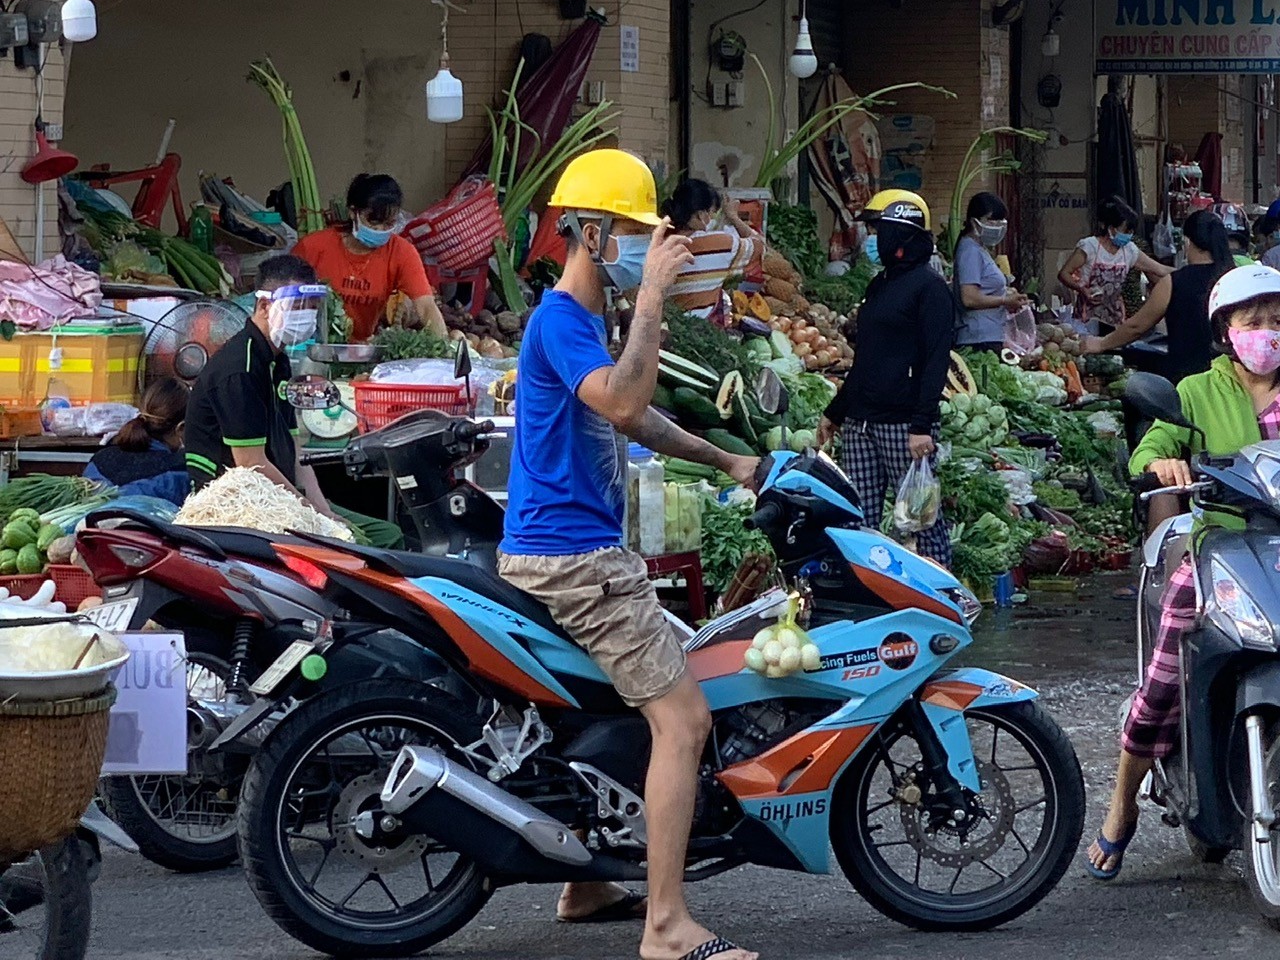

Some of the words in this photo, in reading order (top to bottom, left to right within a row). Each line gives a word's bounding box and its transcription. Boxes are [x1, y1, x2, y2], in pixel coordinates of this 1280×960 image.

[1101, 30, 1174, 58] CHUYÊN
[1179, 36, 1230, 57] CUNG
[1234, 27, 1273, 56] CẤP
[846, 651, 877, 665] Fuels
[880, 642, 918, 660] Gulf
[841, 665, 882, 682] 150
[760, 798, 827, 822] ÖHLINS
